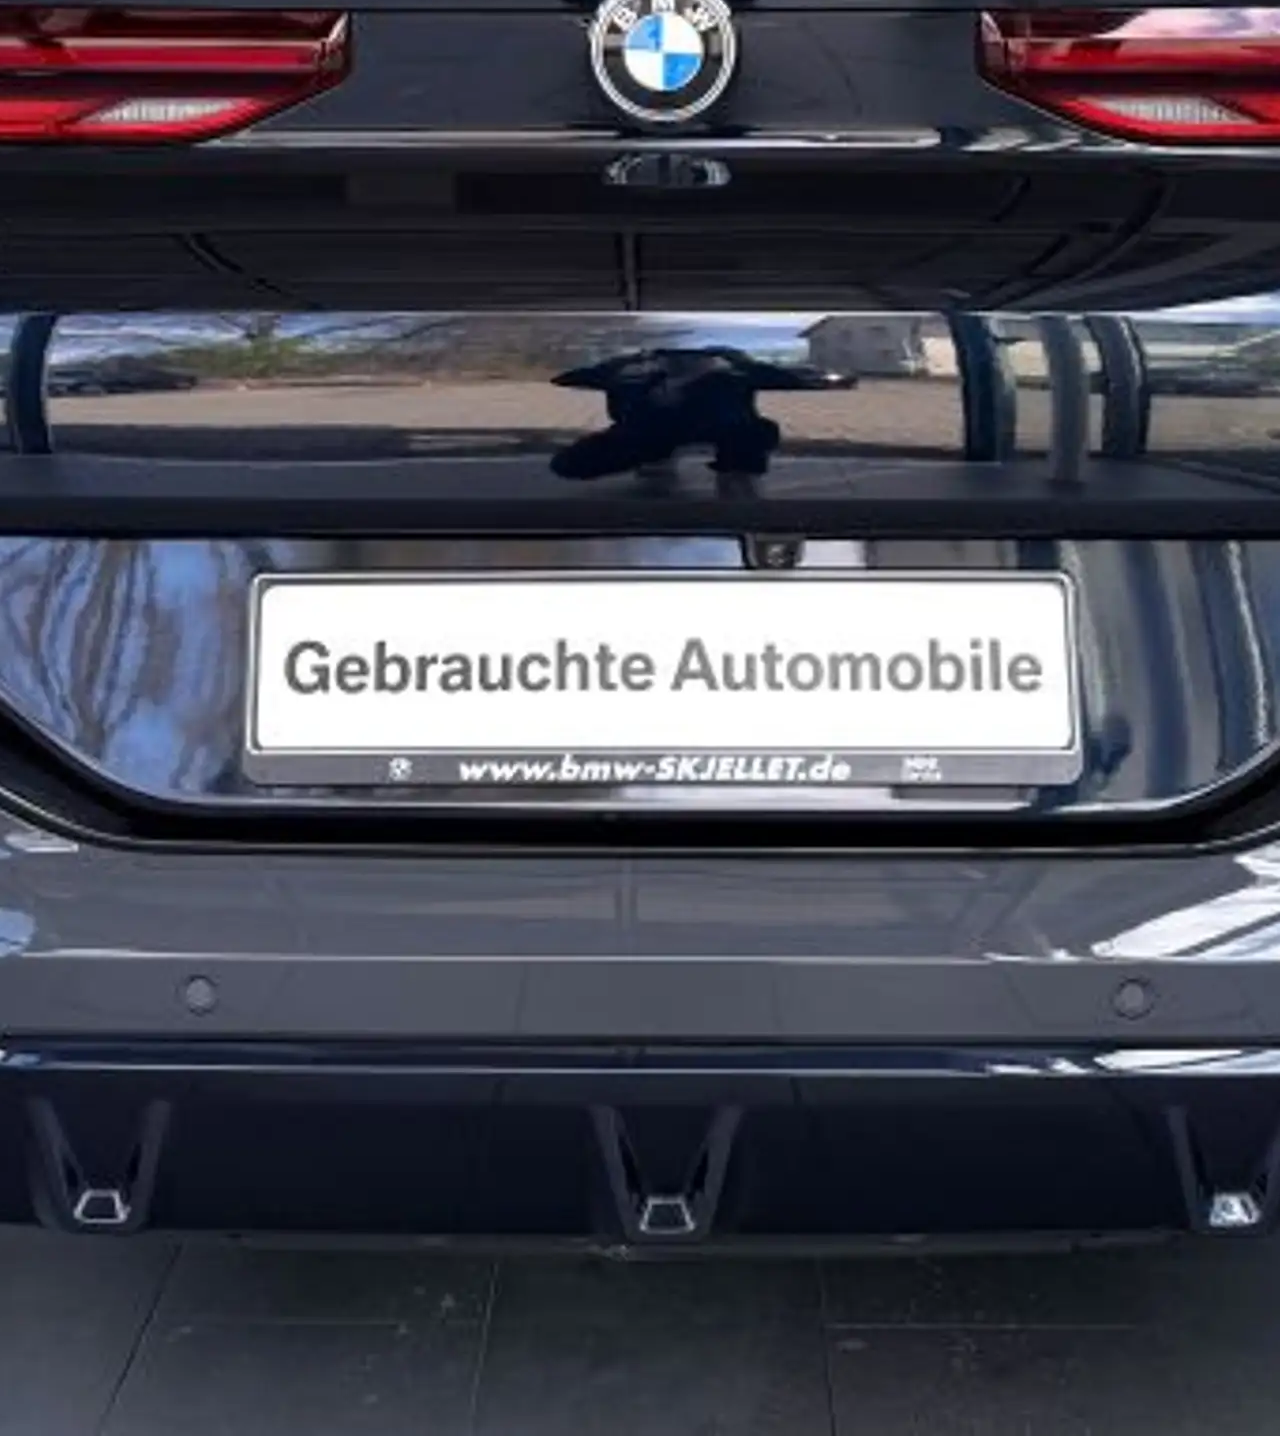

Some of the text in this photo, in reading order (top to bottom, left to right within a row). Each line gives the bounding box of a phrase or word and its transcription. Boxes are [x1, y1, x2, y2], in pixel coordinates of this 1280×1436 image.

[283, 638, 1043, 695] Gebrauchte Automobile
[458, 754, 852, 782] www.bmw-SKJELLET.de
